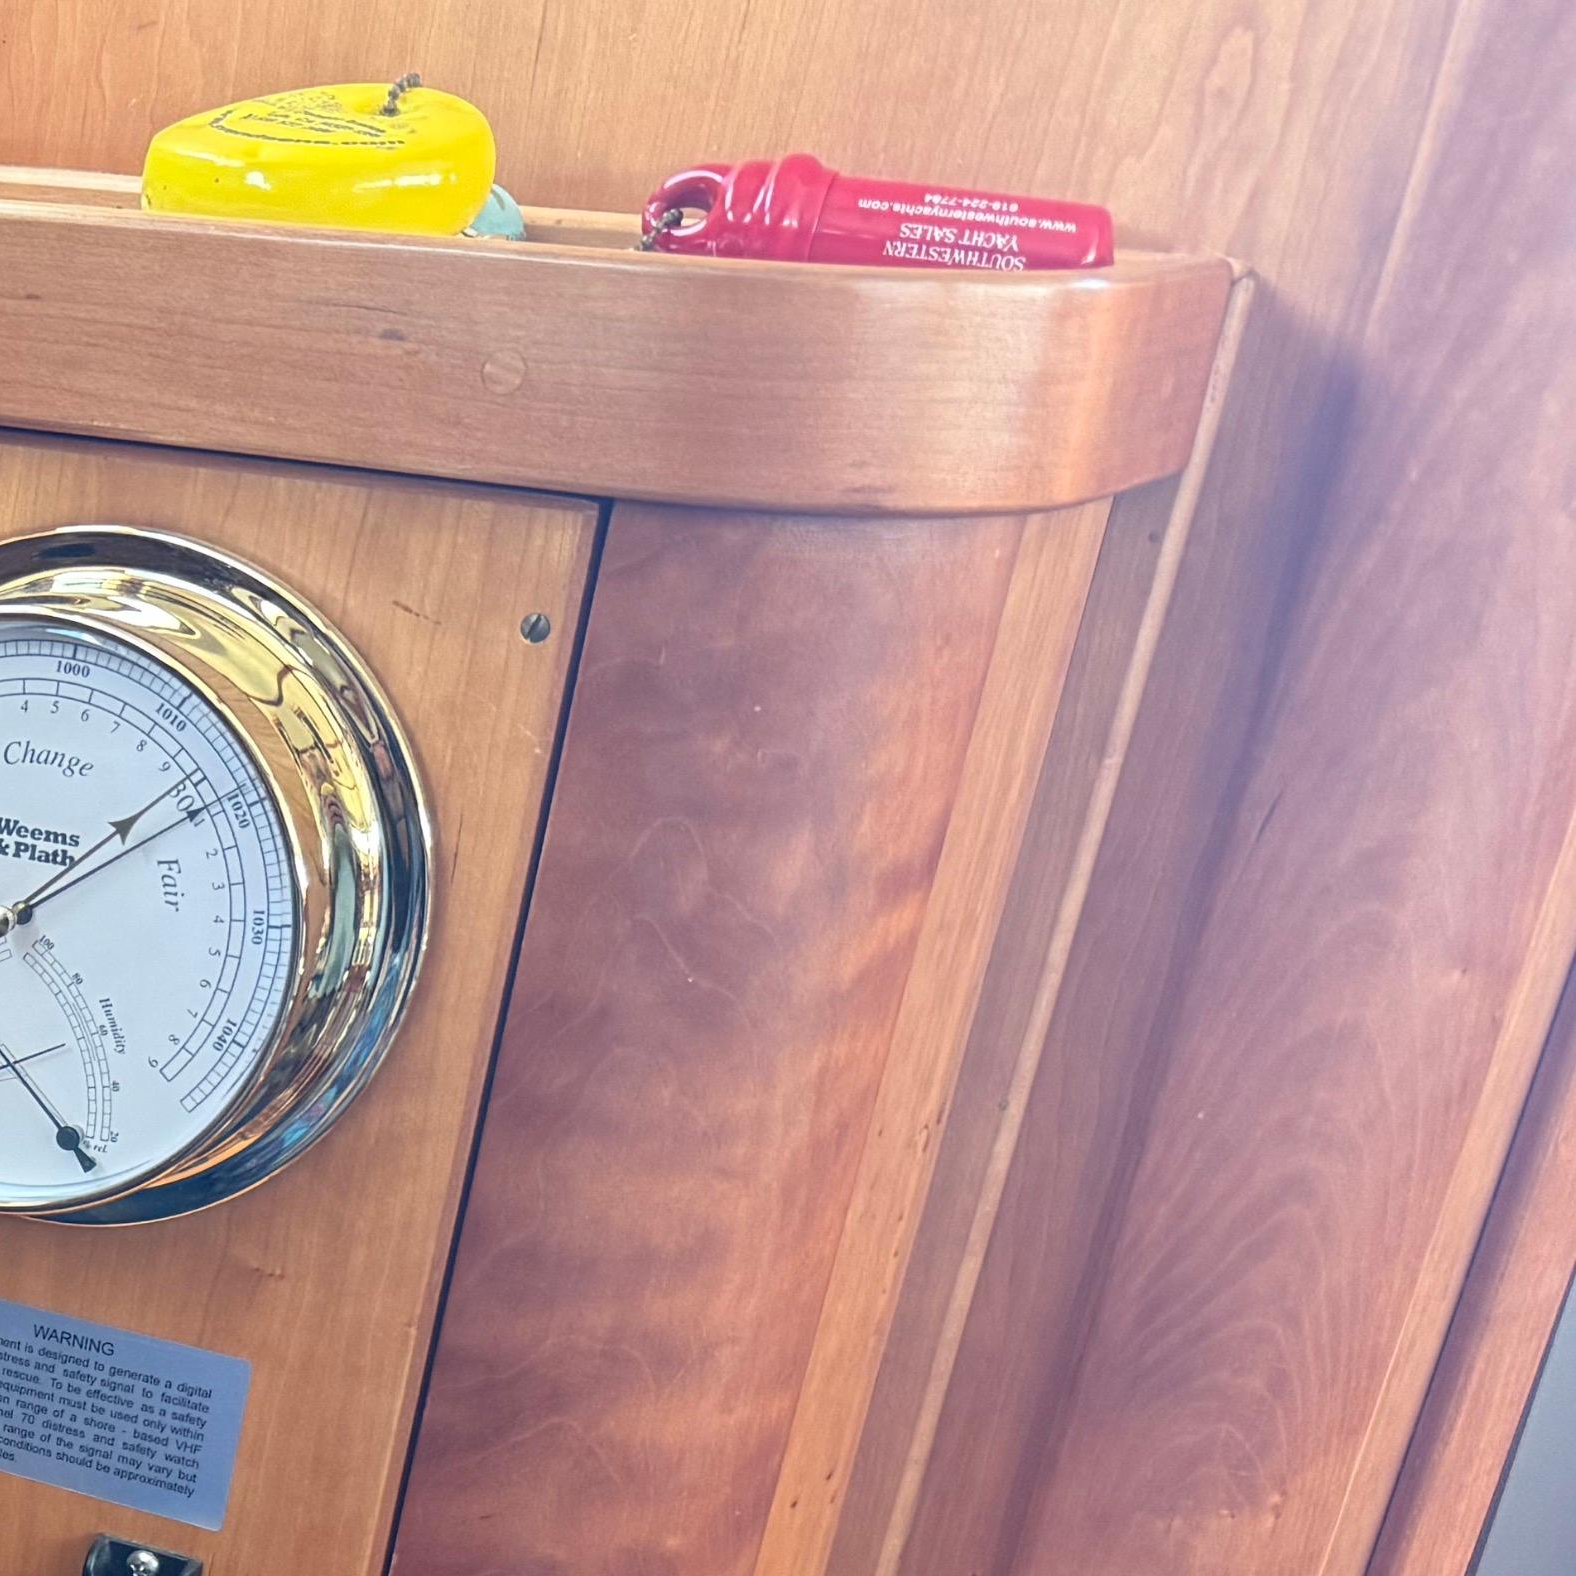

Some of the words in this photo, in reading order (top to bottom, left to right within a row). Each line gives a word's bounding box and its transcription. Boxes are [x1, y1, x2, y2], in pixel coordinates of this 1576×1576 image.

[858, 199, 1076, 232] www.southwesternyachts.com
[899, 224, 956, 243] SALES
[883, 240, 1026, 271] SOUTHWESTERN
[958, 229, 1019, 252] YACHT
[56, 661, 90, 678] 1000
[155, 703, 187, 732] 1010
[3, 740, 94, 778] Change
[227, 793, 250, 829] 1020
[157, 857, 184, 911] Fair
[252, 910, 265, 945] 1030
[99, 998, 127, 1055] Humidity
[213, 1018, 237, 1052] 1040
[33, 1323, 115, 1356] WARNING
[25, 1343, 33, 1354] is
[38, 1347, 89, 1367] designed
[94, 1361, 104, 1371] to
[109, 1366, 160, 1386] generate
[165, 1380, 172, 1389] a
[177, 1384, 212, 1398] digital
[34, 1359, 55, 1373] and
[63, 1368, 96, 1385] safety
[100, 1378, 135, 1394] signal
[142, 1388, 153, 1399] to
[161, 1393, 210, 1413] facilitate
[50, 1378, 63, 1390] To
[68, 1383, 81, 1395] be
[86, 1390, 134, 1408] effective
[141, 1404, 155, 1413] as
[159, 1409, 166, 1417] a
[171, 1411, 207, 1430] safety
[59, 1396, 87, 1411] must
[91, 1403, 106, 1415] be
[110, 1409, 139, 1424] used
[143, 1418, 167, 1433] only
[170, 1425, 205, 1442] within
[16, 1400, 48, 1416] range
[53, 1409, 65, 1418] of
[69, 1414, 77, 1422] a
[84, 1416, 116, 1433] shore
[133, 1429, 169, 1447] based
[176, 1439, 202, 1455] VHF
[21, 1412, 35, 1425] 70
[41, 1420, 86, 1438] distress
[93, 1433, 115, 1446] and
[122, 1441, 157, 1459] safety
[165, 1453, 199, 1469] watch
[3, 1424, 35, 1439] range
[40, 1434, 52, 1443] of
[56, 1437, 73, 1449] the
[79, 1444, 113, 1460] signal
[117, 1454, 142, 1470] may
[148, 1462, 173, 1478] vary
[178, 1470, 197, 1483] but
[56, 1451, 92, 1468] should
[96, 1462, 110, 1474] be
[113, 1467, 195, 1498] approximately
